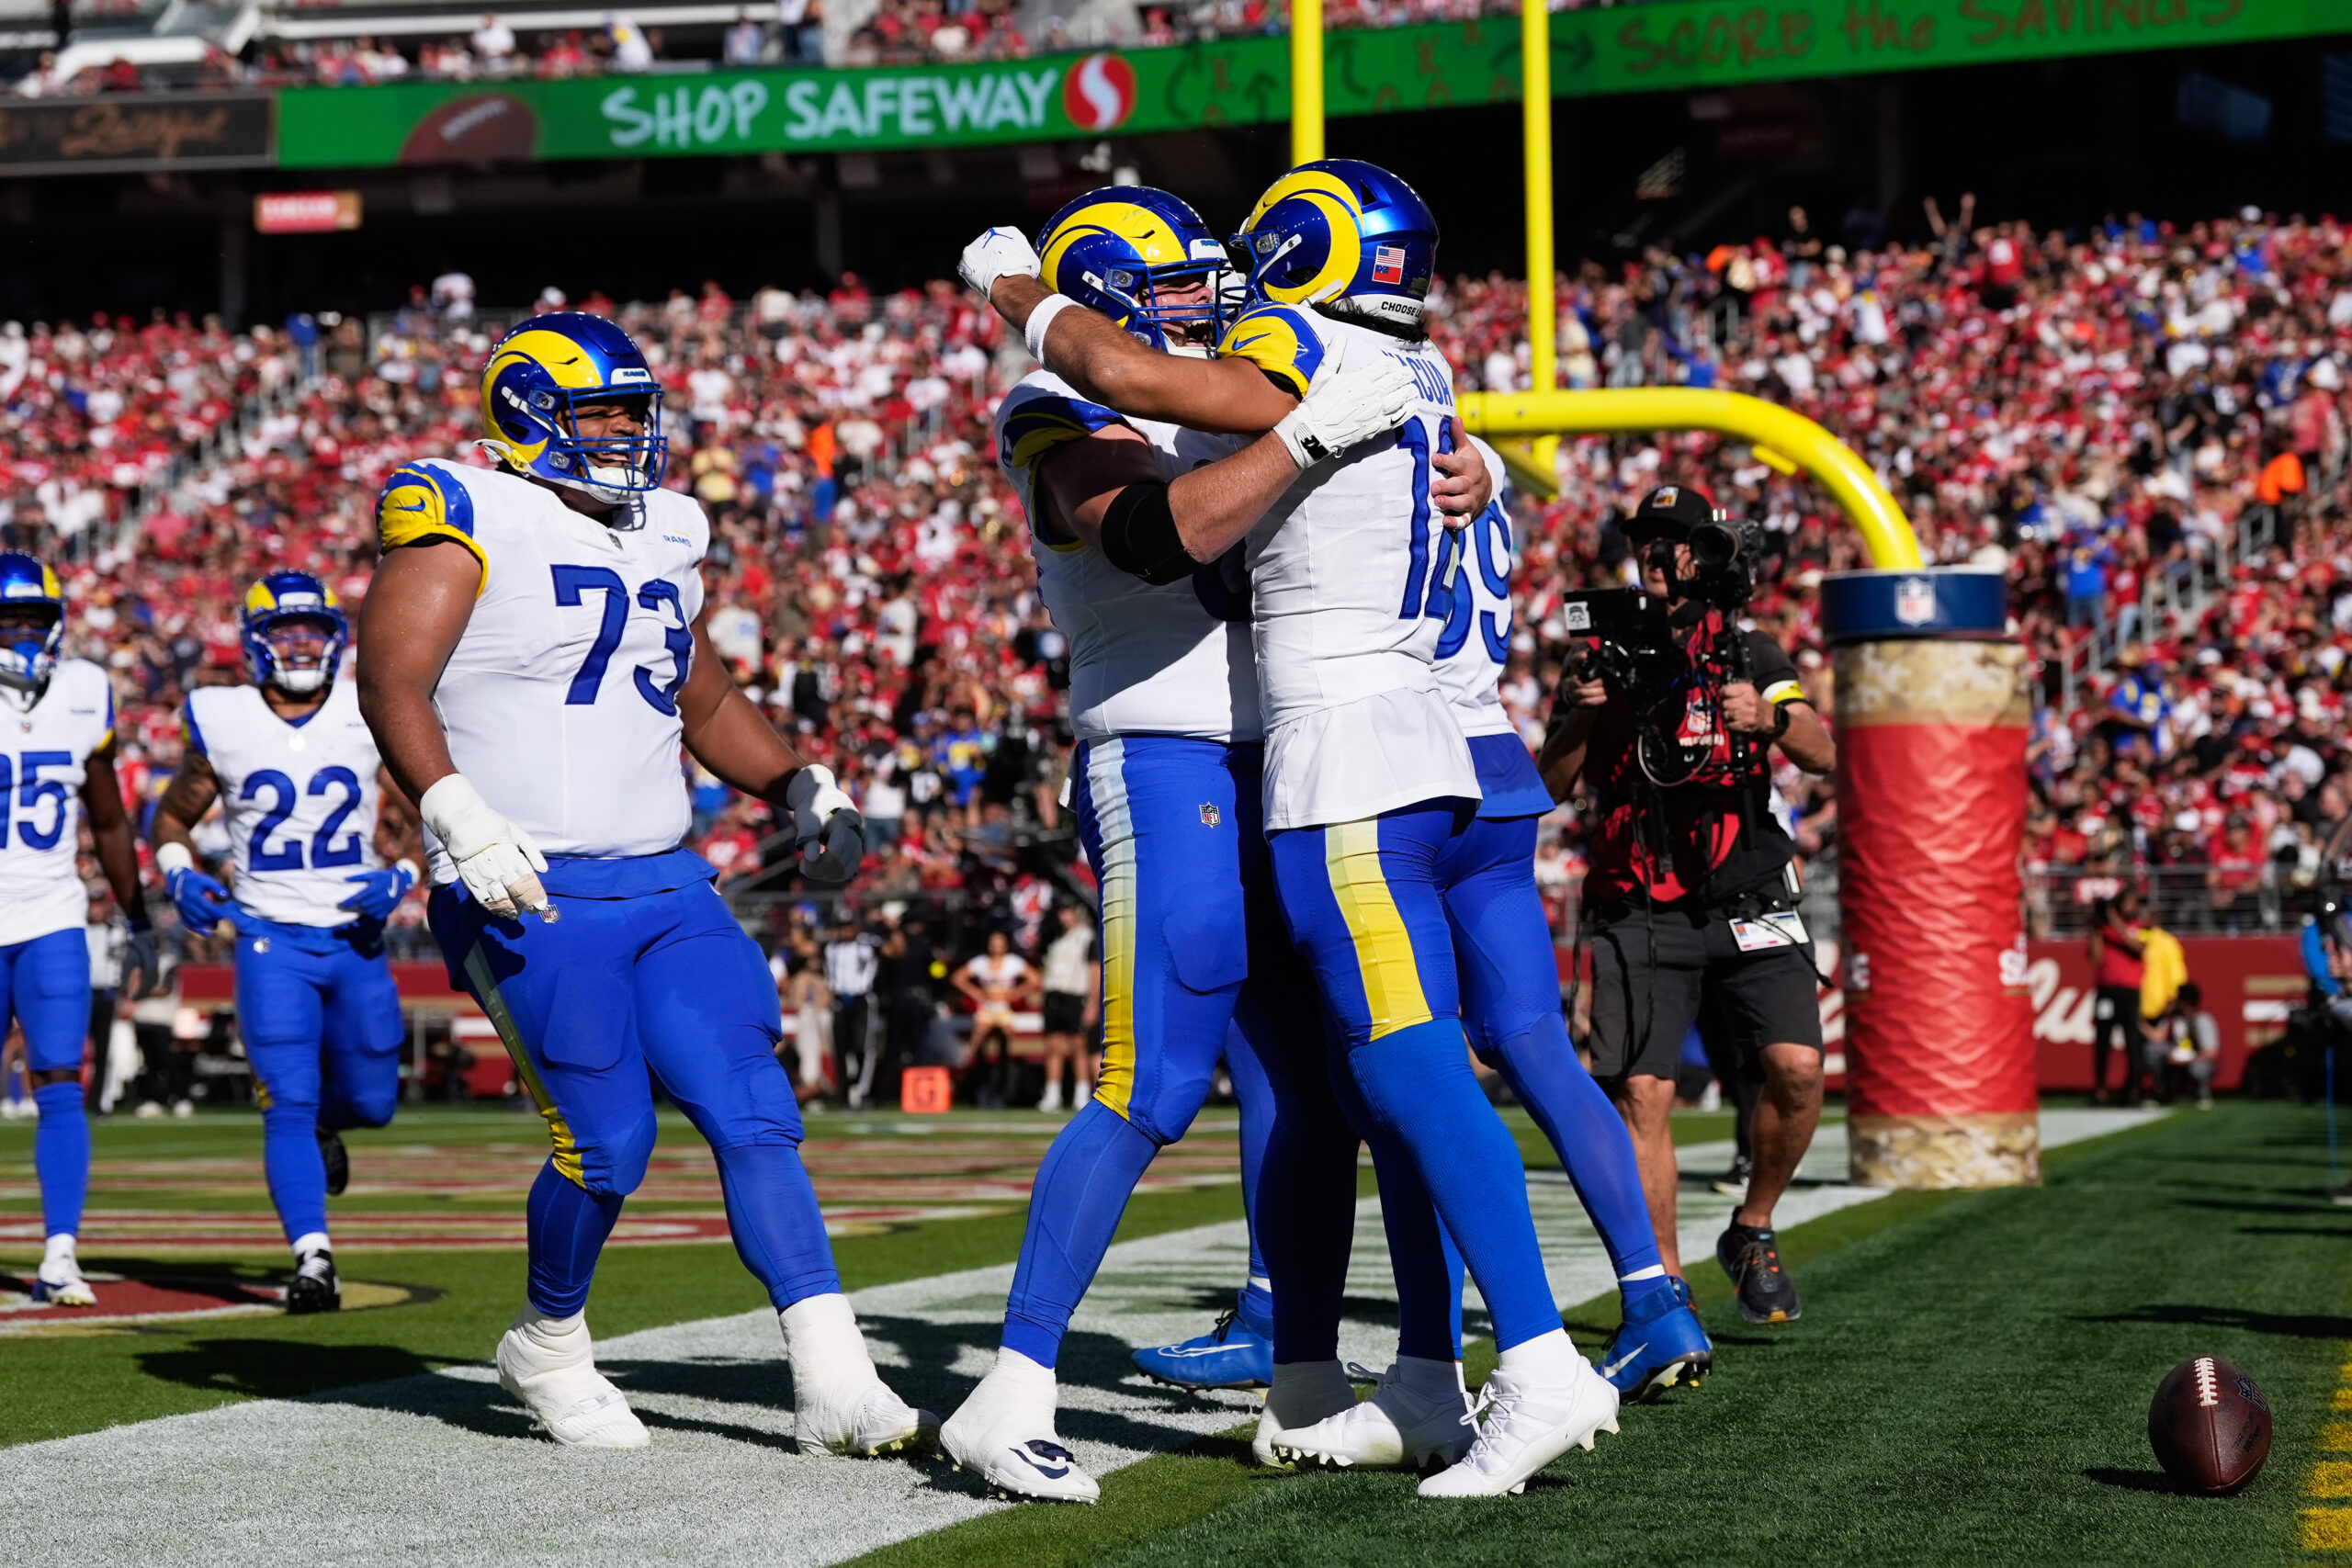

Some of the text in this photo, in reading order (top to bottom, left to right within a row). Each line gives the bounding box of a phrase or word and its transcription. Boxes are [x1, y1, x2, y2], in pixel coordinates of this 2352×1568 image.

[601, 69, 1057, 148] SHOP SAFEWAY
[1381, 300, 1416, 317] CHOOSE
[551, 564, 695, 717] 73
[241, 765, 362, 872] 22
